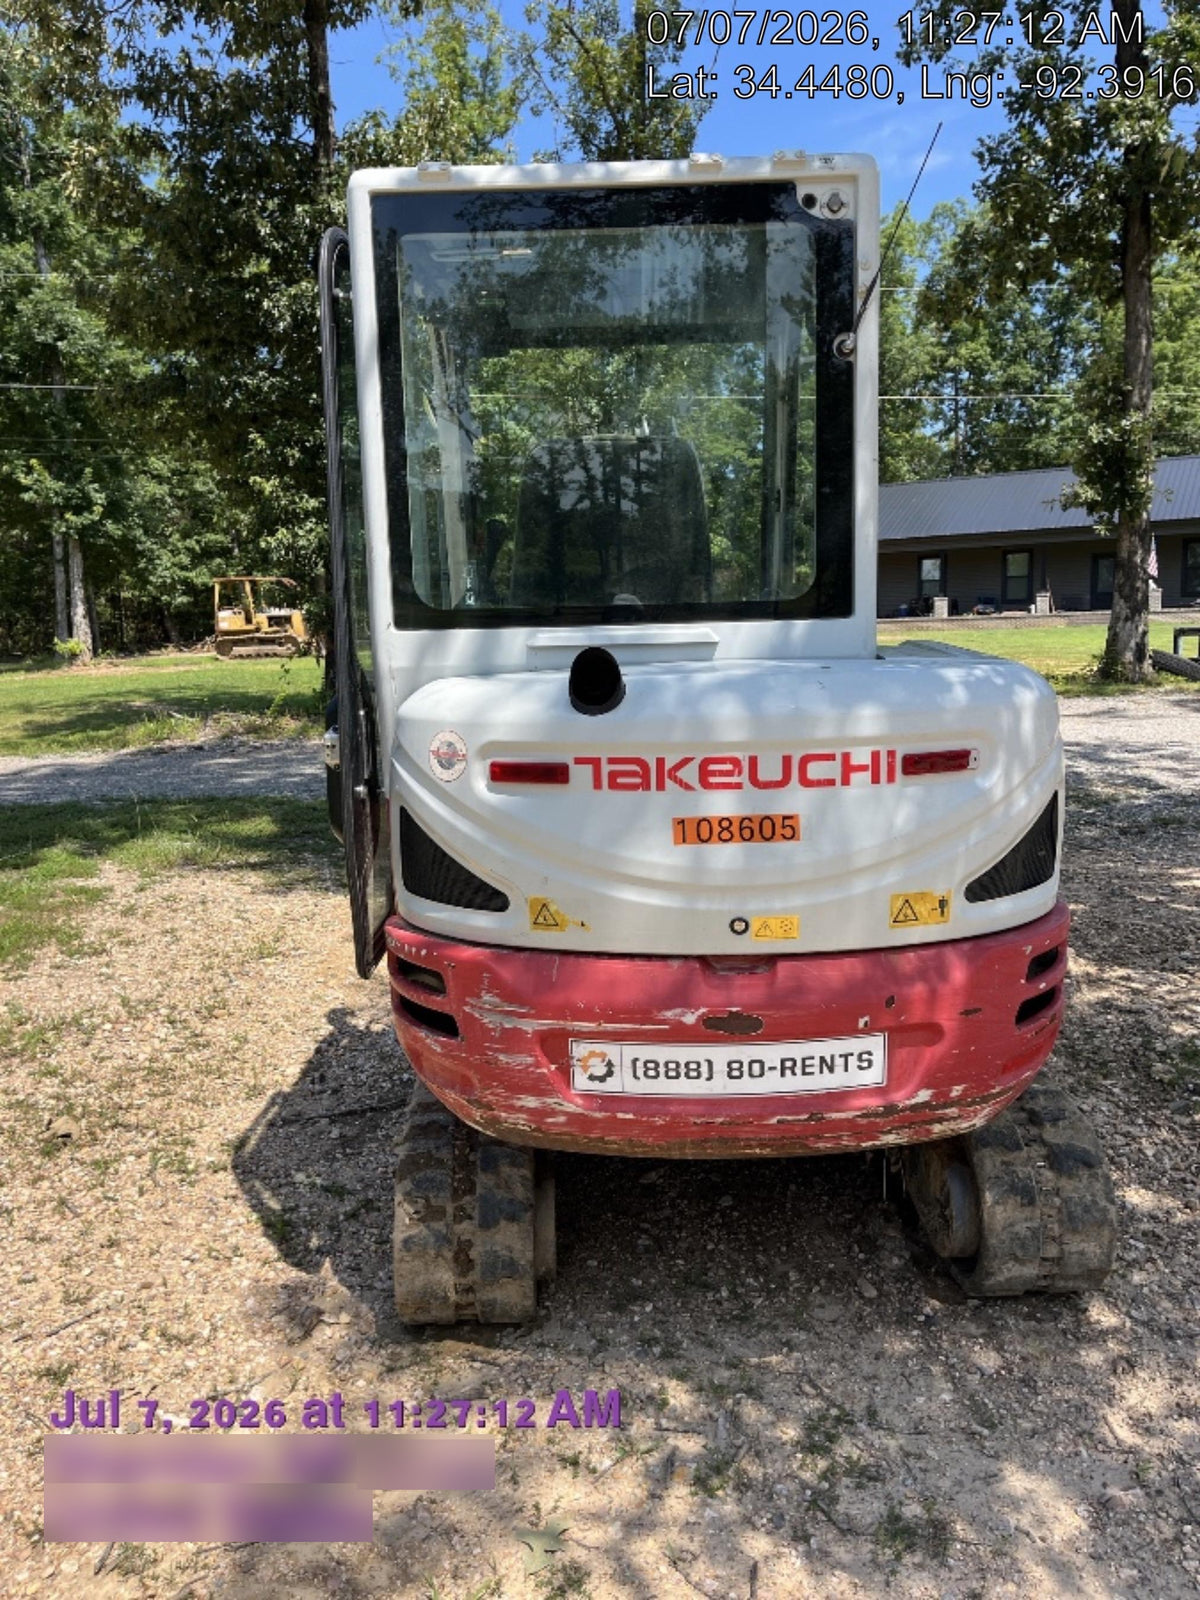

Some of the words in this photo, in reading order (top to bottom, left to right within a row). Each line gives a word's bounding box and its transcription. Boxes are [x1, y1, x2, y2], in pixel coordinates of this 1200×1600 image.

[675, 814, 797, 844] 108605
[631, 1058, 713, 1081] (888)
[726, 1050, 874, 1081] 80-RENTS
